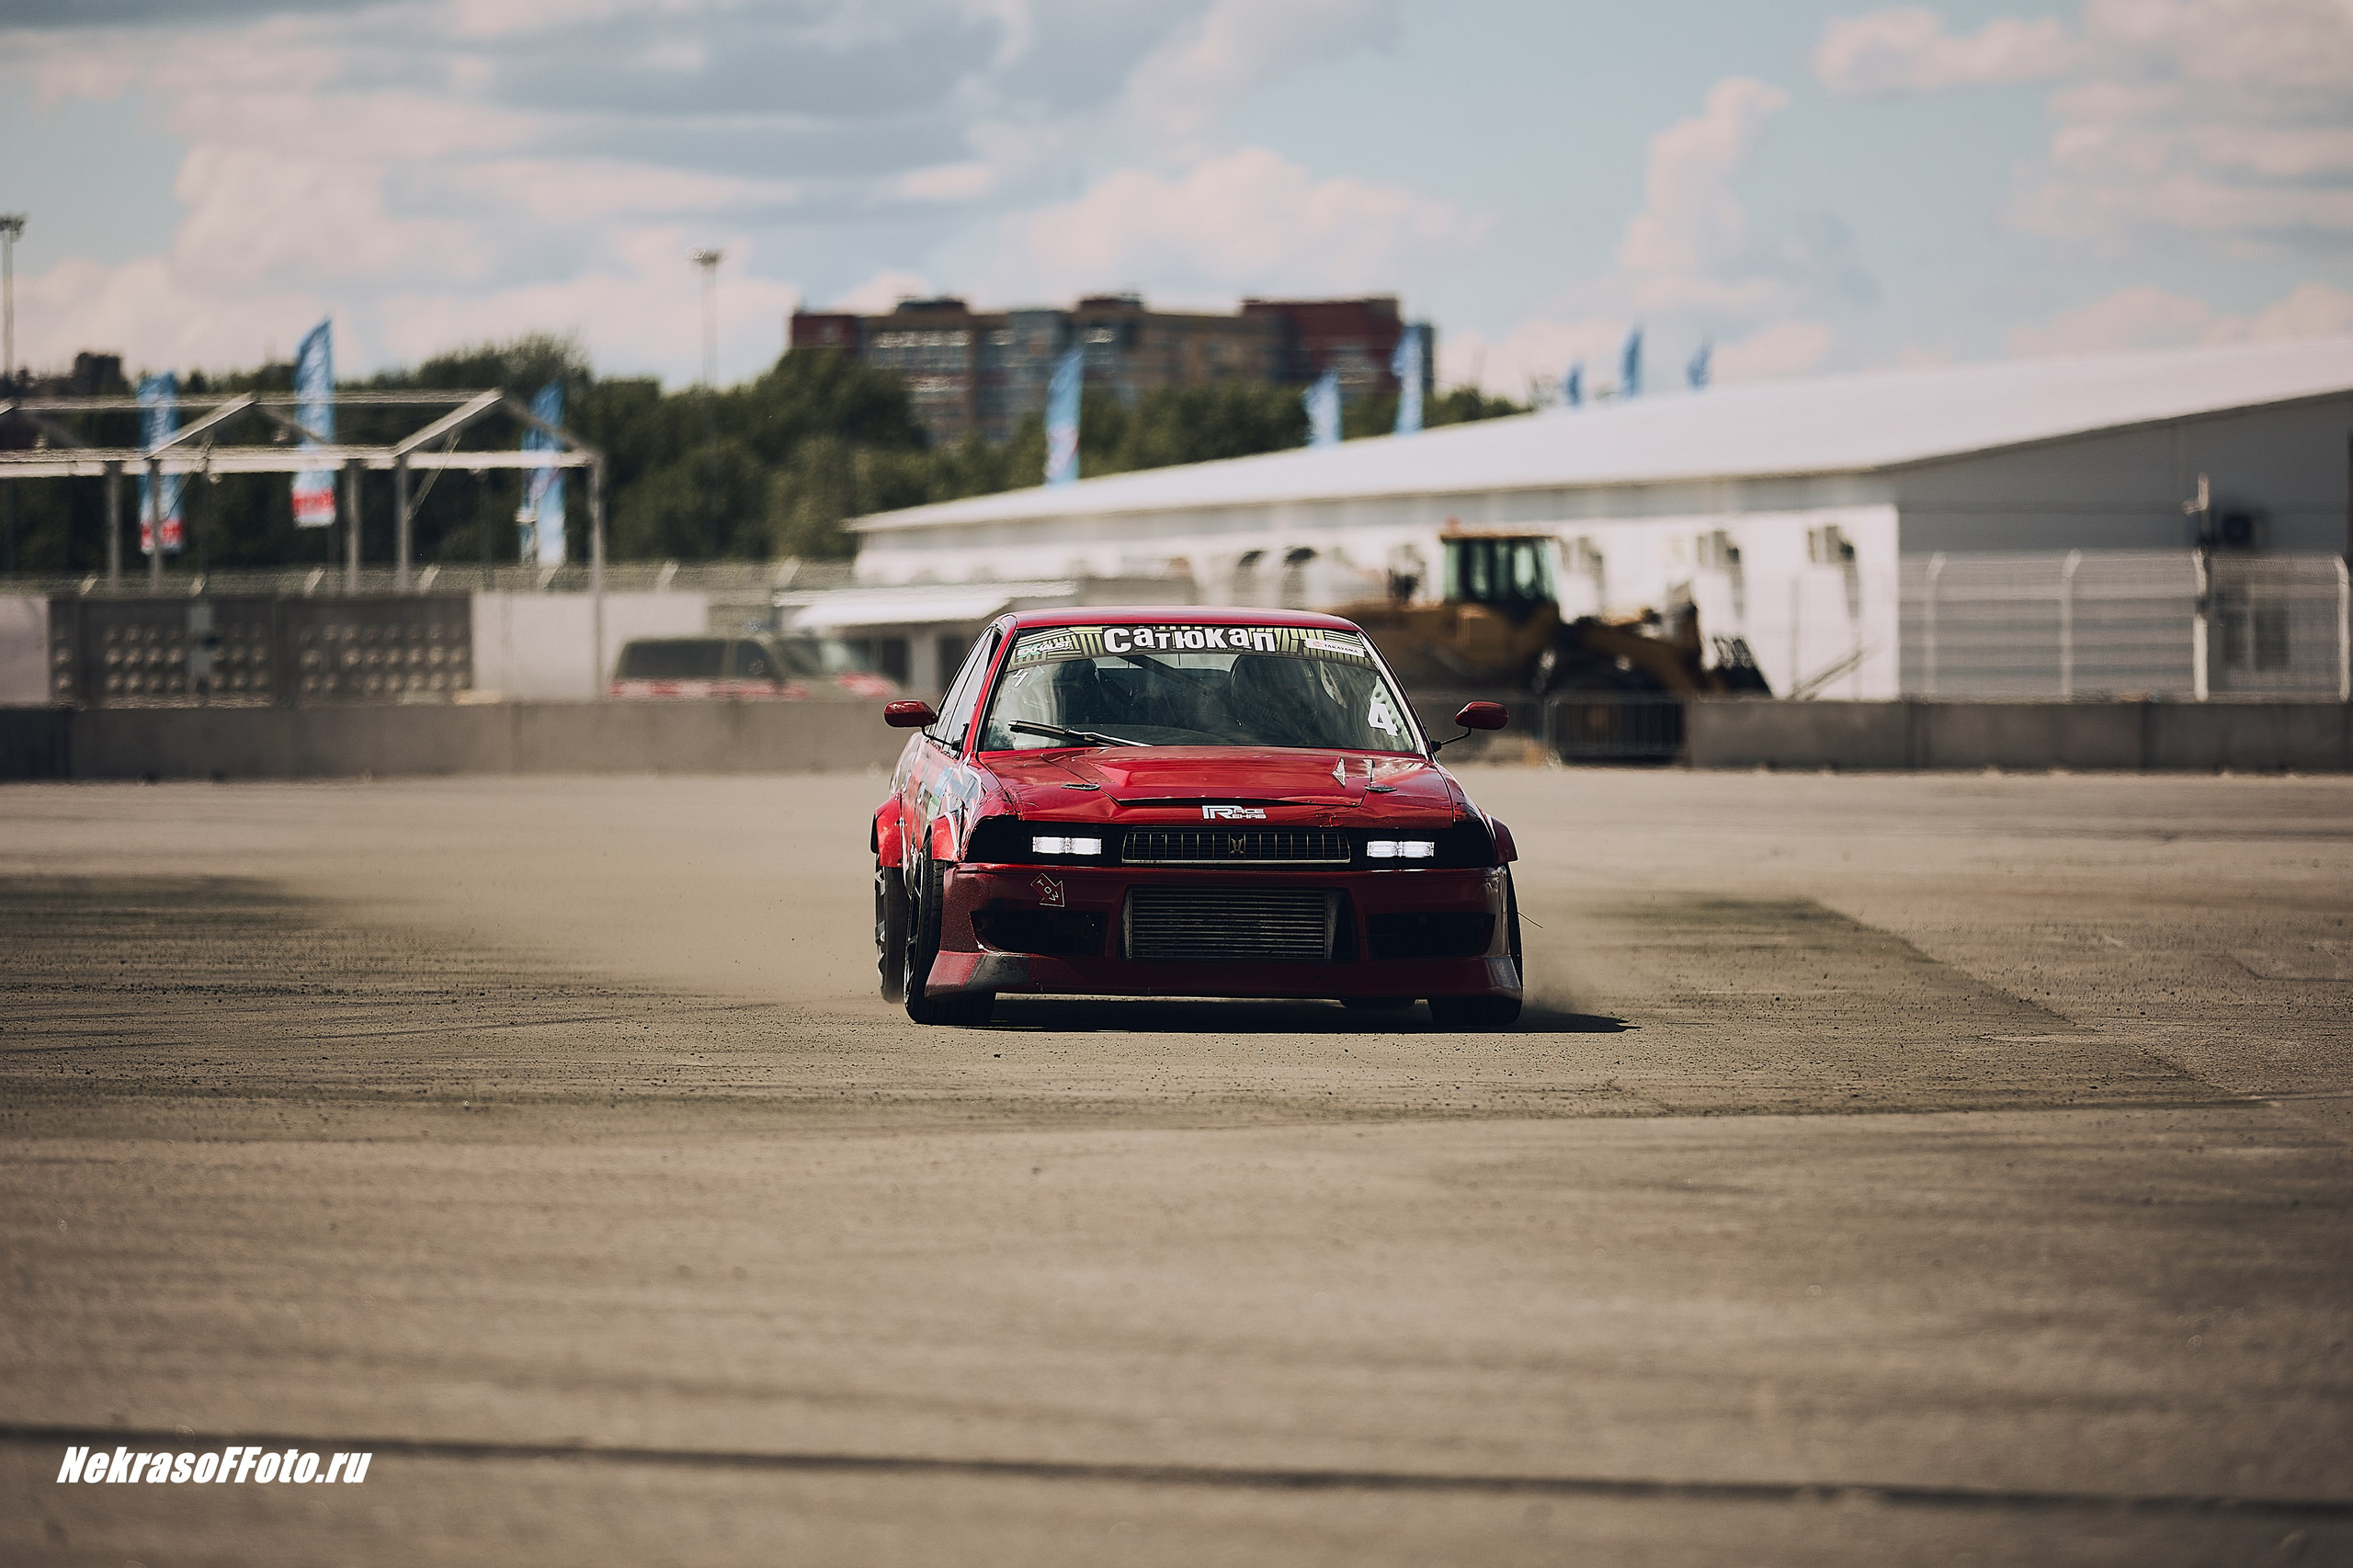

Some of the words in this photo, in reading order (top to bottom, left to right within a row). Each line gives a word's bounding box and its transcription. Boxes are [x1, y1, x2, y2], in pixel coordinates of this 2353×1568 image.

[1324, 644, 1358, 653] TAKAYAMA
[1368, 702, 1398, 736] 4
[1037, 879, 1059, 901] TOW
